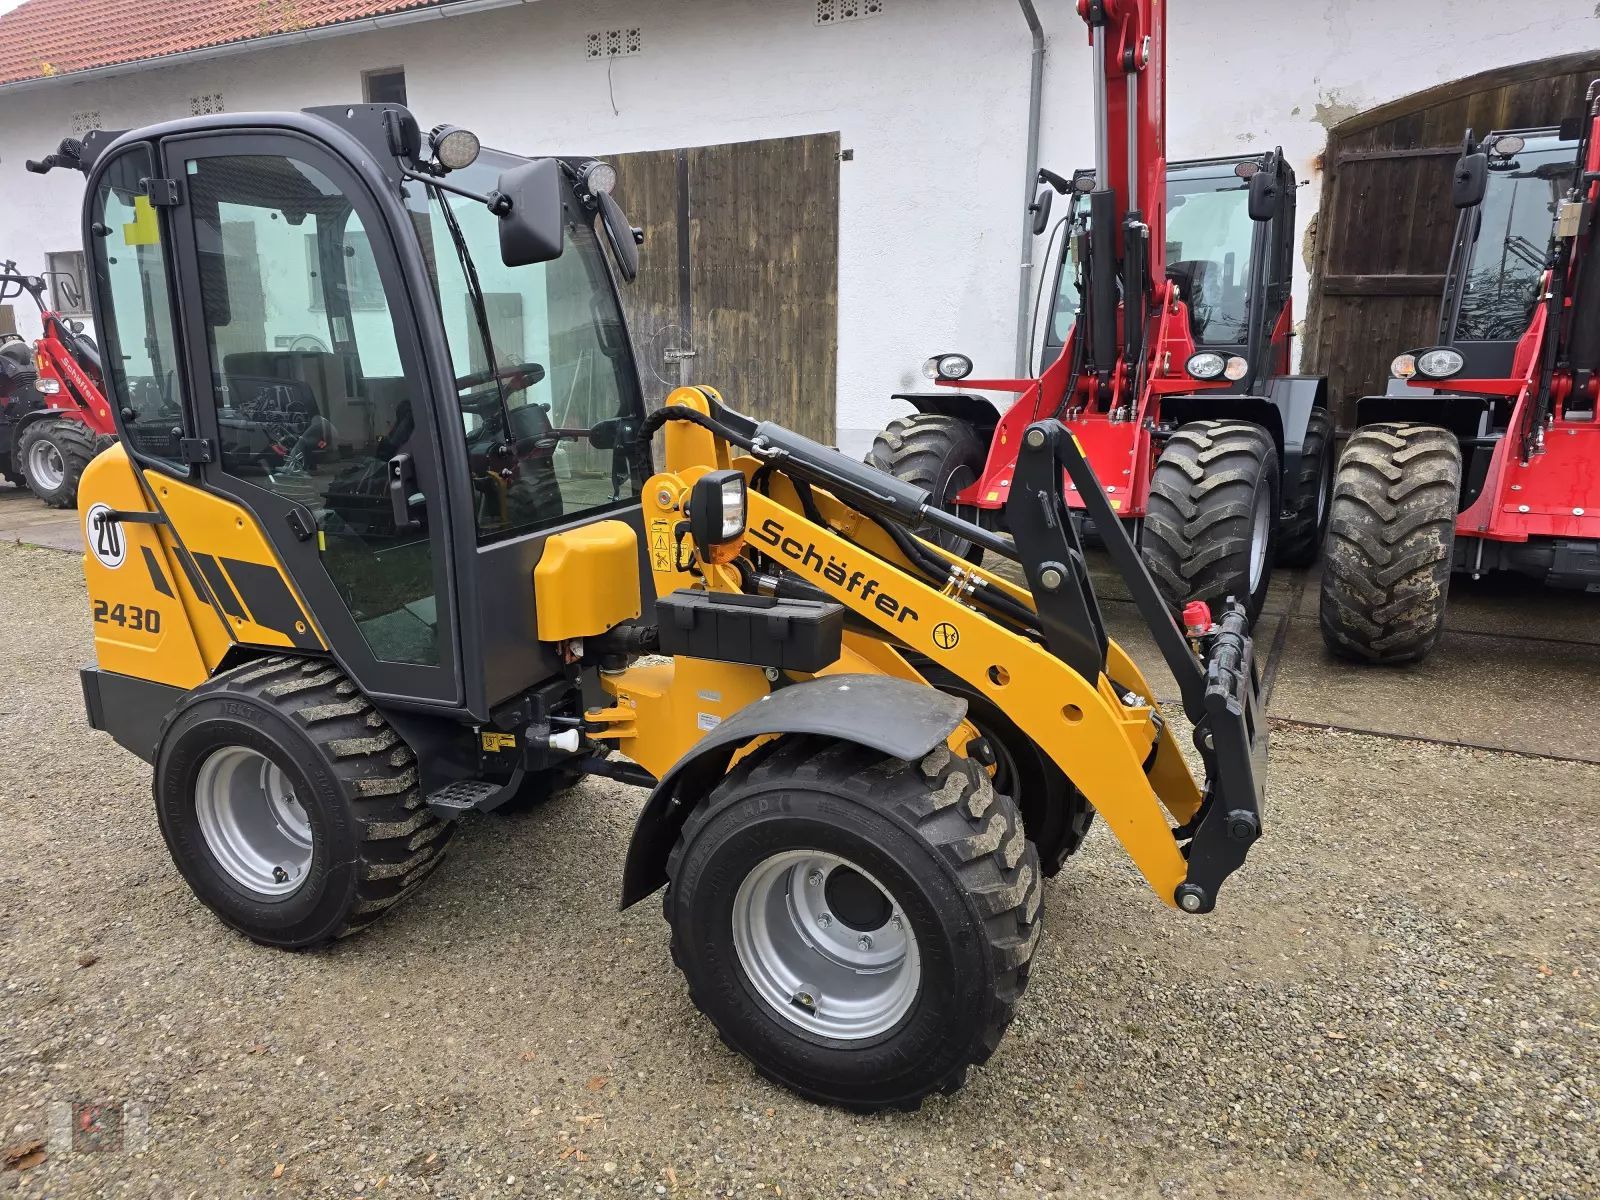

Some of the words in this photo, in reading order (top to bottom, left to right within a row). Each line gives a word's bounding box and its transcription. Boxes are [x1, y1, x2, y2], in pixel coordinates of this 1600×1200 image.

[93, 514, 121, 558] 20
[748, 518, 919, 624] Schäffer
[94, 599, 161, 634] 2430
